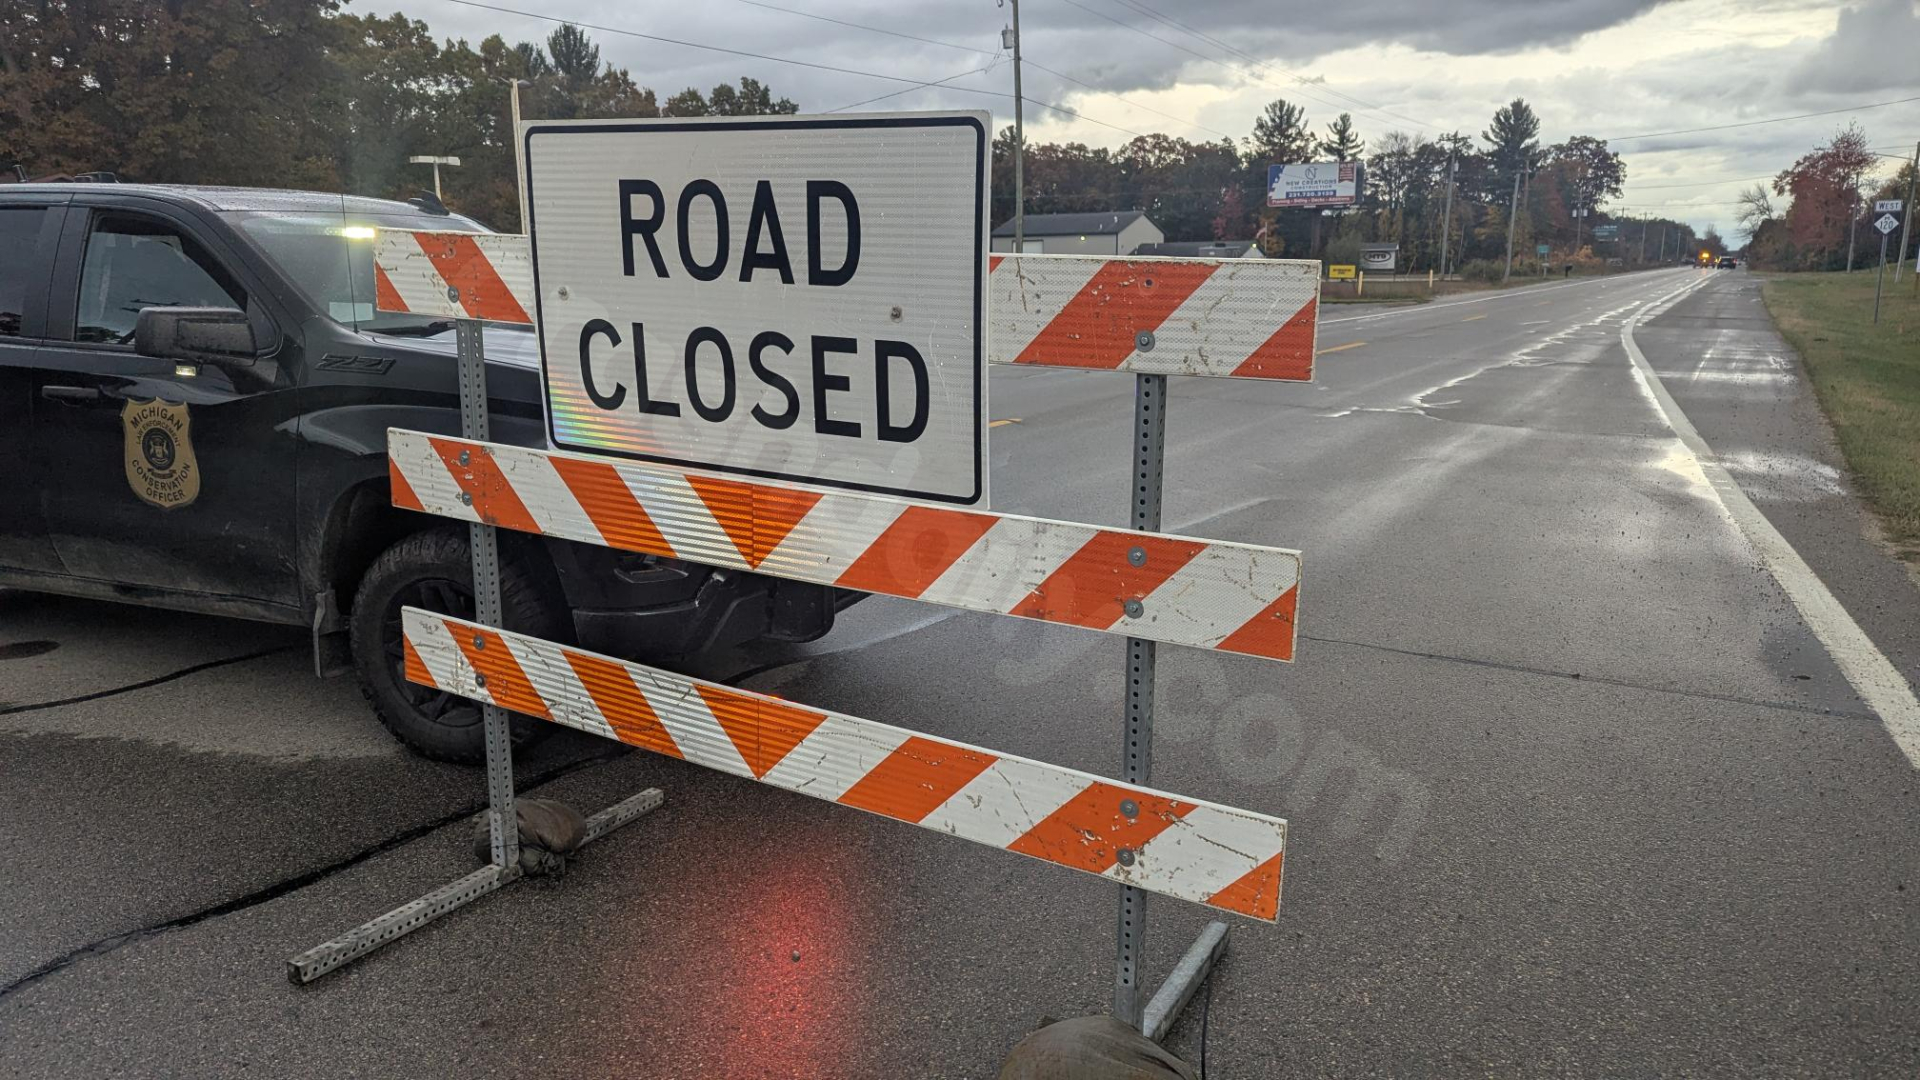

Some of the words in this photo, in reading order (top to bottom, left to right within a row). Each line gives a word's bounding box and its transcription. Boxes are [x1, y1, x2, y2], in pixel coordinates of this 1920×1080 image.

[1879, 202, 1899, 210] WEST
[618, 179, 862, 286] ROAD
[1880, 221, 1894, 229] 120
[579, 318, 930, 443] CLOSED
[130, 406, 183, 431] MICHIGAN
[142, 420, 181, 447] ENFORCEMENT
[132, 459, 190, 491] CONSERVATION
[146, 487, 185, 502] OFFICER
